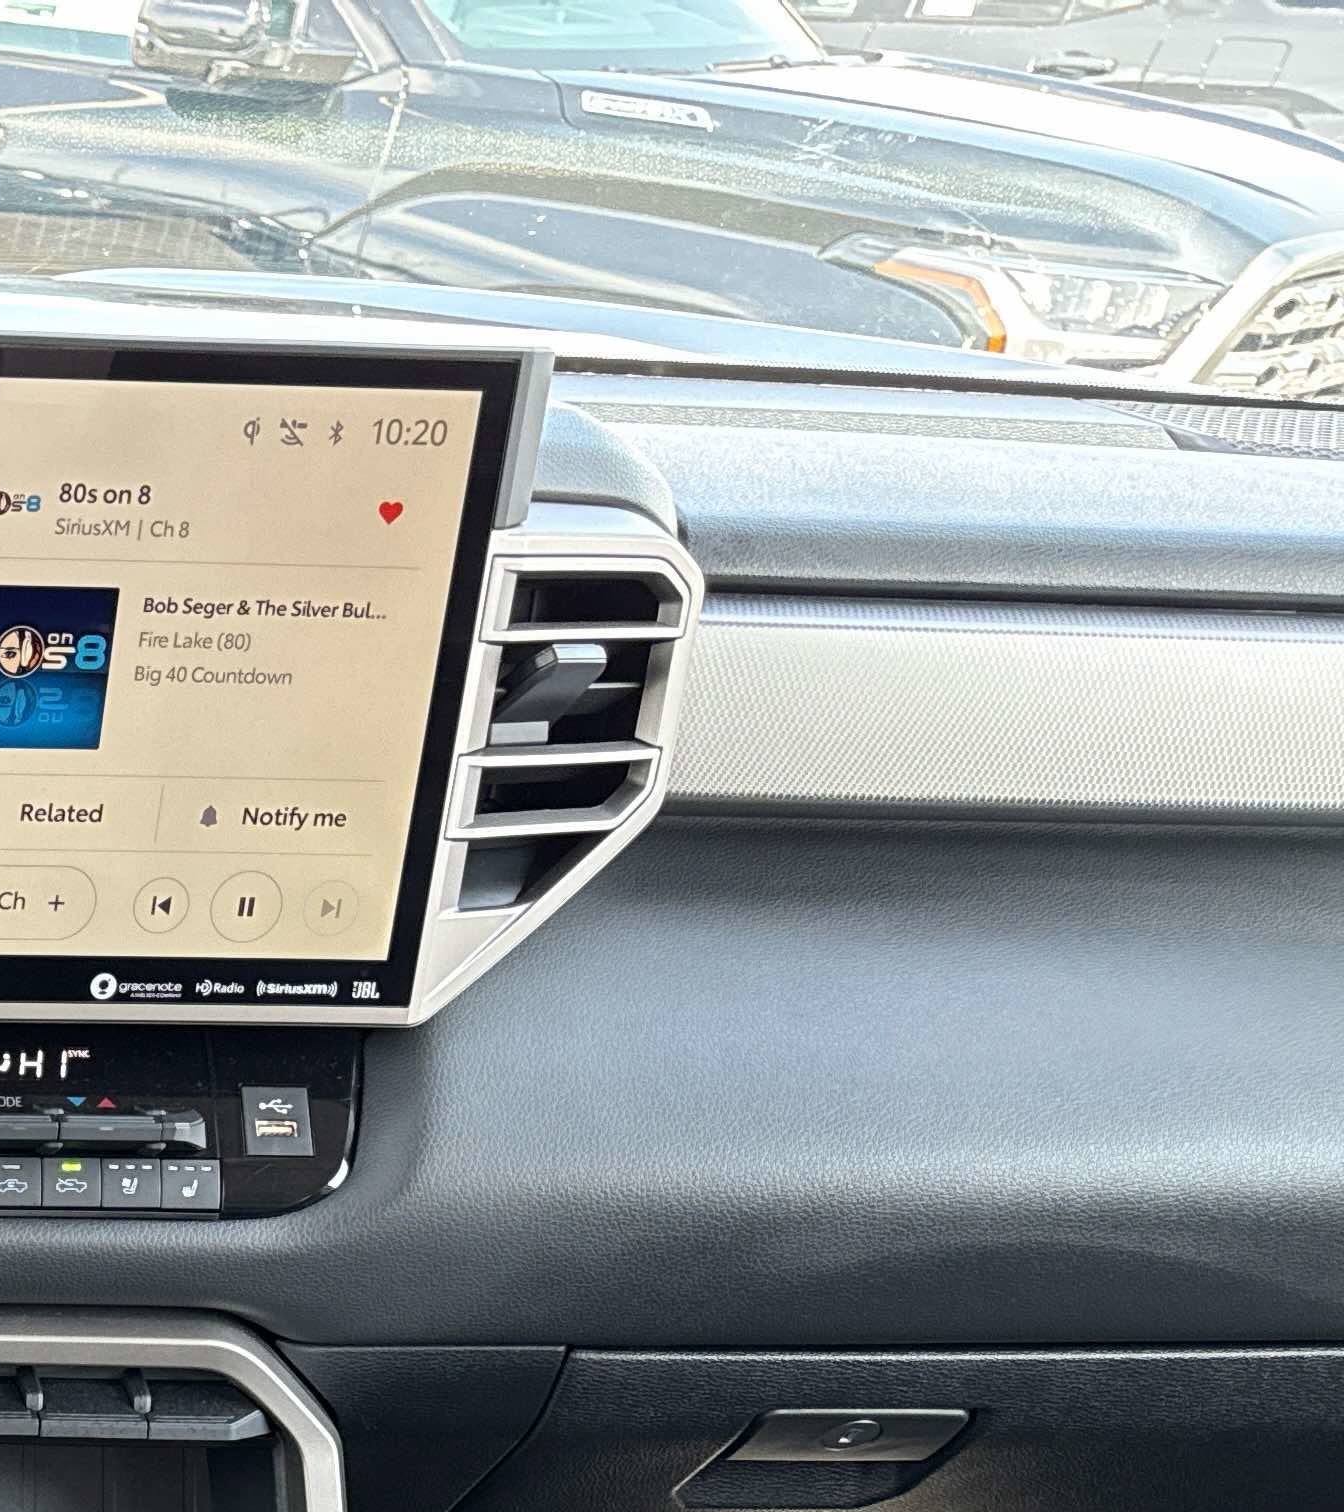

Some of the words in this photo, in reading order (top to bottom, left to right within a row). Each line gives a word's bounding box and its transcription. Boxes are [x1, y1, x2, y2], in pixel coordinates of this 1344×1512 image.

[371, 418, 448, 447] 10:20
[59, 483, 98, 504] 80s
[103, 488, 132, 505] on
[137, 485, 152, 506] 8
[54, 518, 131, 538] SiriusXM
[150, 520, 174, 538] Ch
[178, 521, 190, 539] 8
[143, 598, 178, 616] Bob
[184, 599, 232, 620] Seger
[236, 601, 250, 617] &
[256, 600, 287, 618] The
[292, 600, 338, 619] Silver
[138, 632, 168, 649] Fire
[173, 632, 212, 650] Lake
[217, 632, 251, 653] (80)
[134, 665, 162, 688] Big
[165, 667, 187, 684] 40
[191, 667, 293, 686] Countdown
[19, 803, 104, 823] Related
[241, 807, 308, 829] Notify
[313, 811, 347, 827] me
[119, 980, 182, 994] gracenote
[214, 982, 244, 994] Radio
[352, 981, 380, 999] JBL
